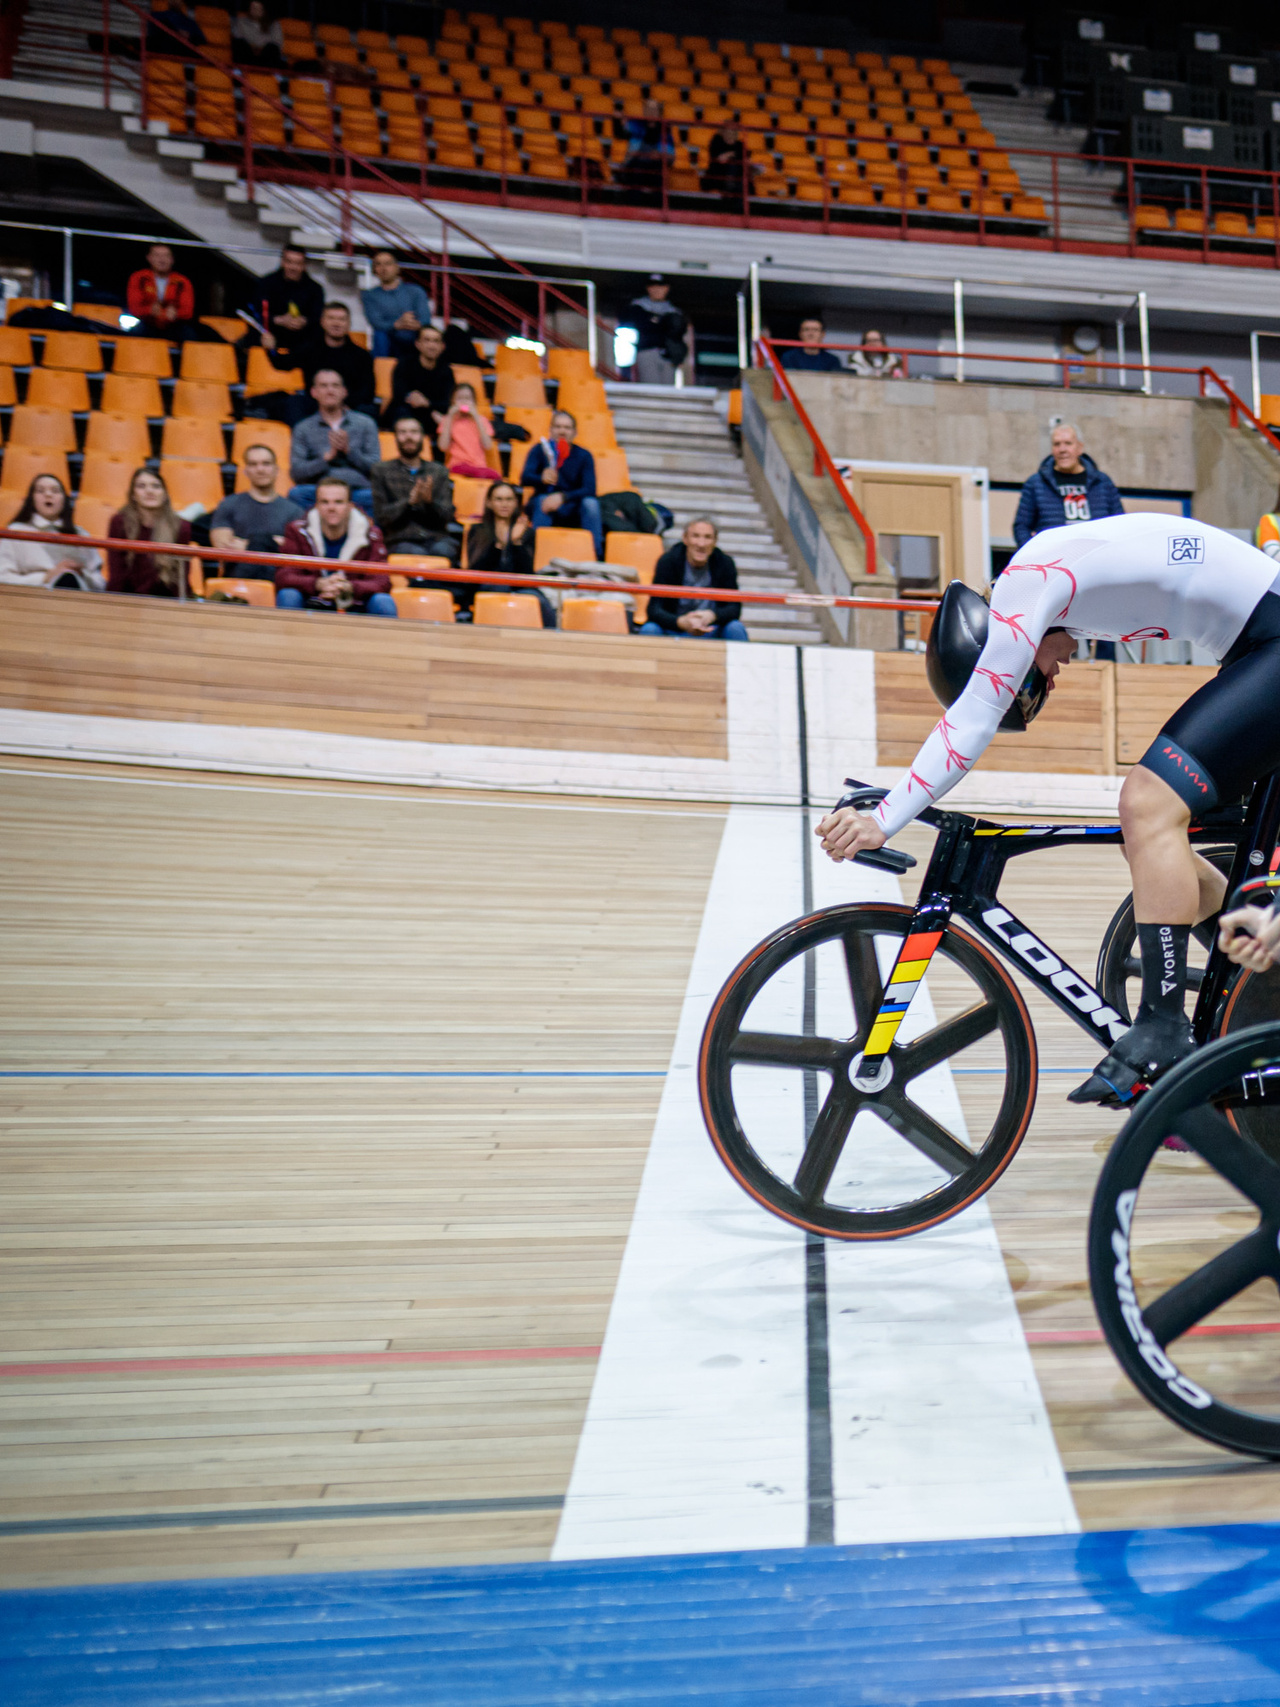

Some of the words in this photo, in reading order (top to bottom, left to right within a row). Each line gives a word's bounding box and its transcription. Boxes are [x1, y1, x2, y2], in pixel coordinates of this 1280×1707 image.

[1171, 547, 1202, 561] CAT
[1173, 537, 1202, 550] FAT
[982, 907, 1131, 1042] LOOK
[1159, 926, 1176, 979] VORTEQ
[1110, 1188, 1213, 1409] CORIMA
